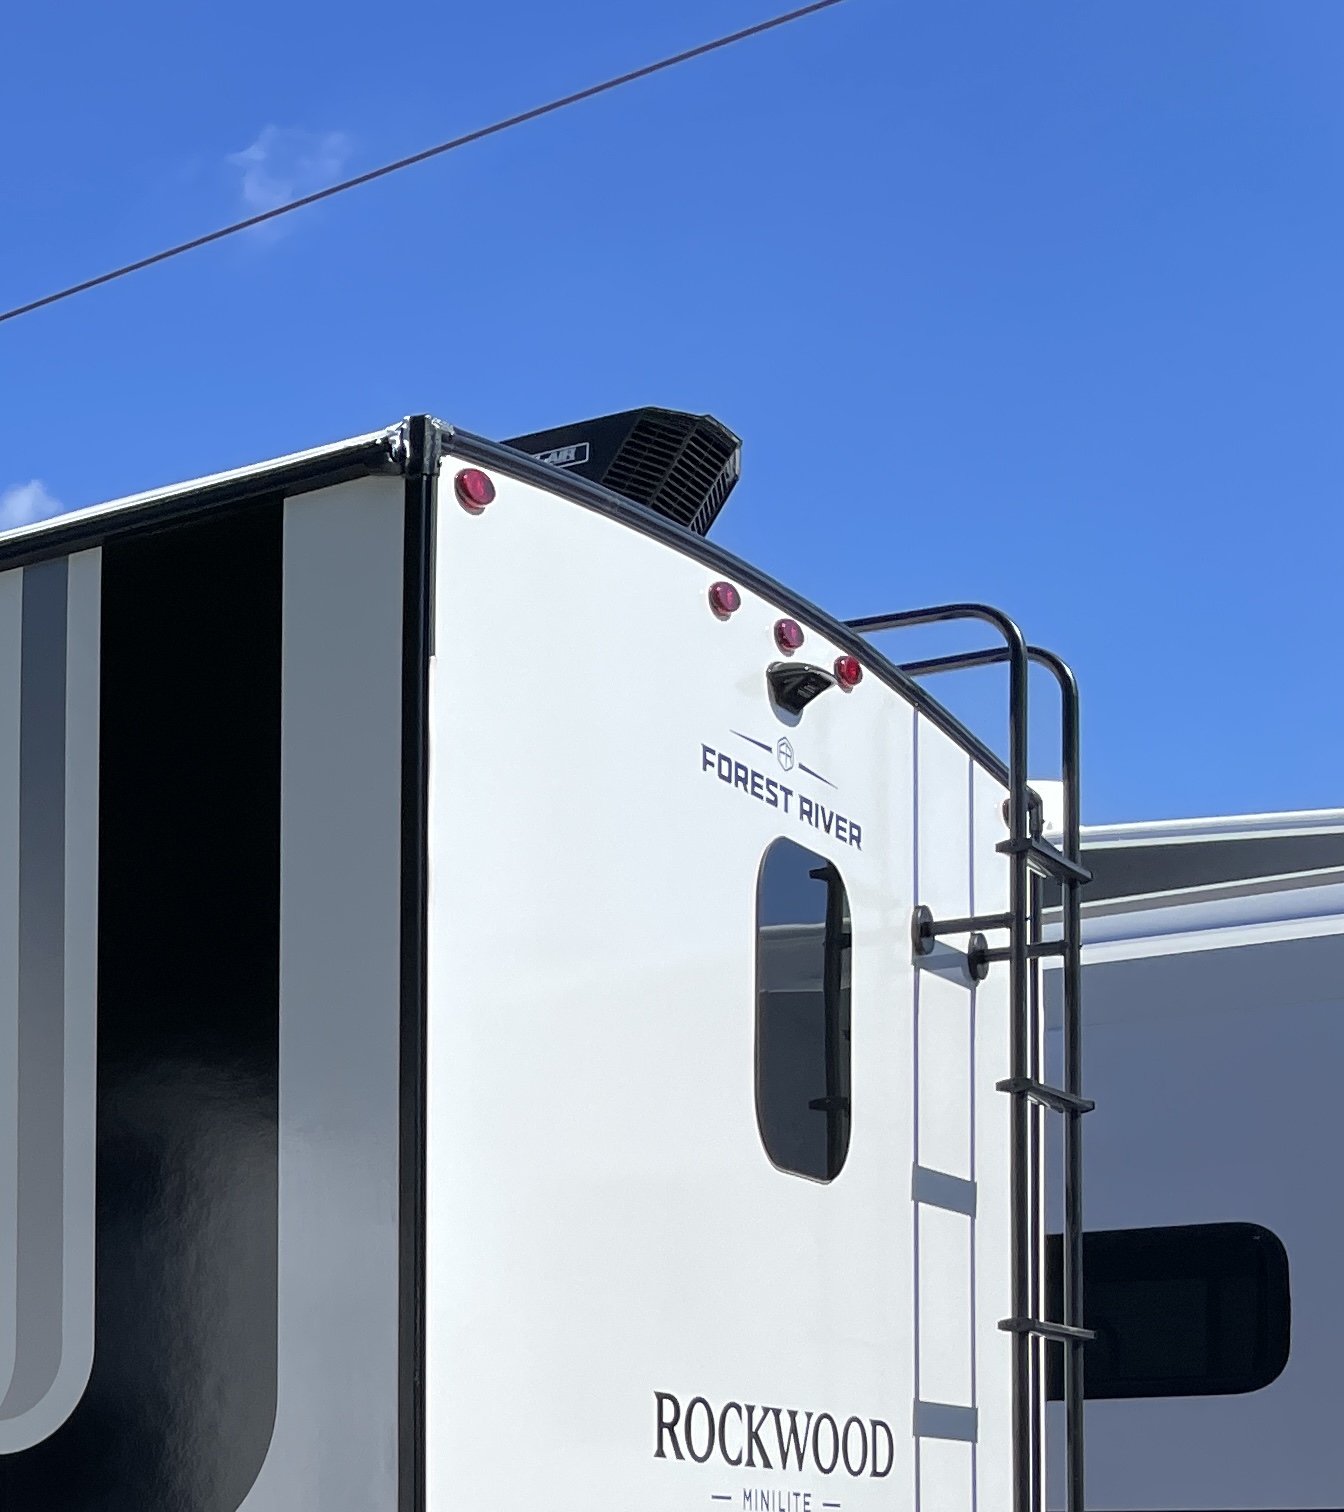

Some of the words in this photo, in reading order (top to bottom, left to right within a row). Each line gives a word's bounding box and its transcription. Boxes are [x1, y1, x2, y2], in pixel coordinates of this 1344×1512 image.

[701, 743, 794, 814] FOREST
[798, 794, 863, 851] RIVER
[653, 1390, 894, 1478] ROCKWOOD
